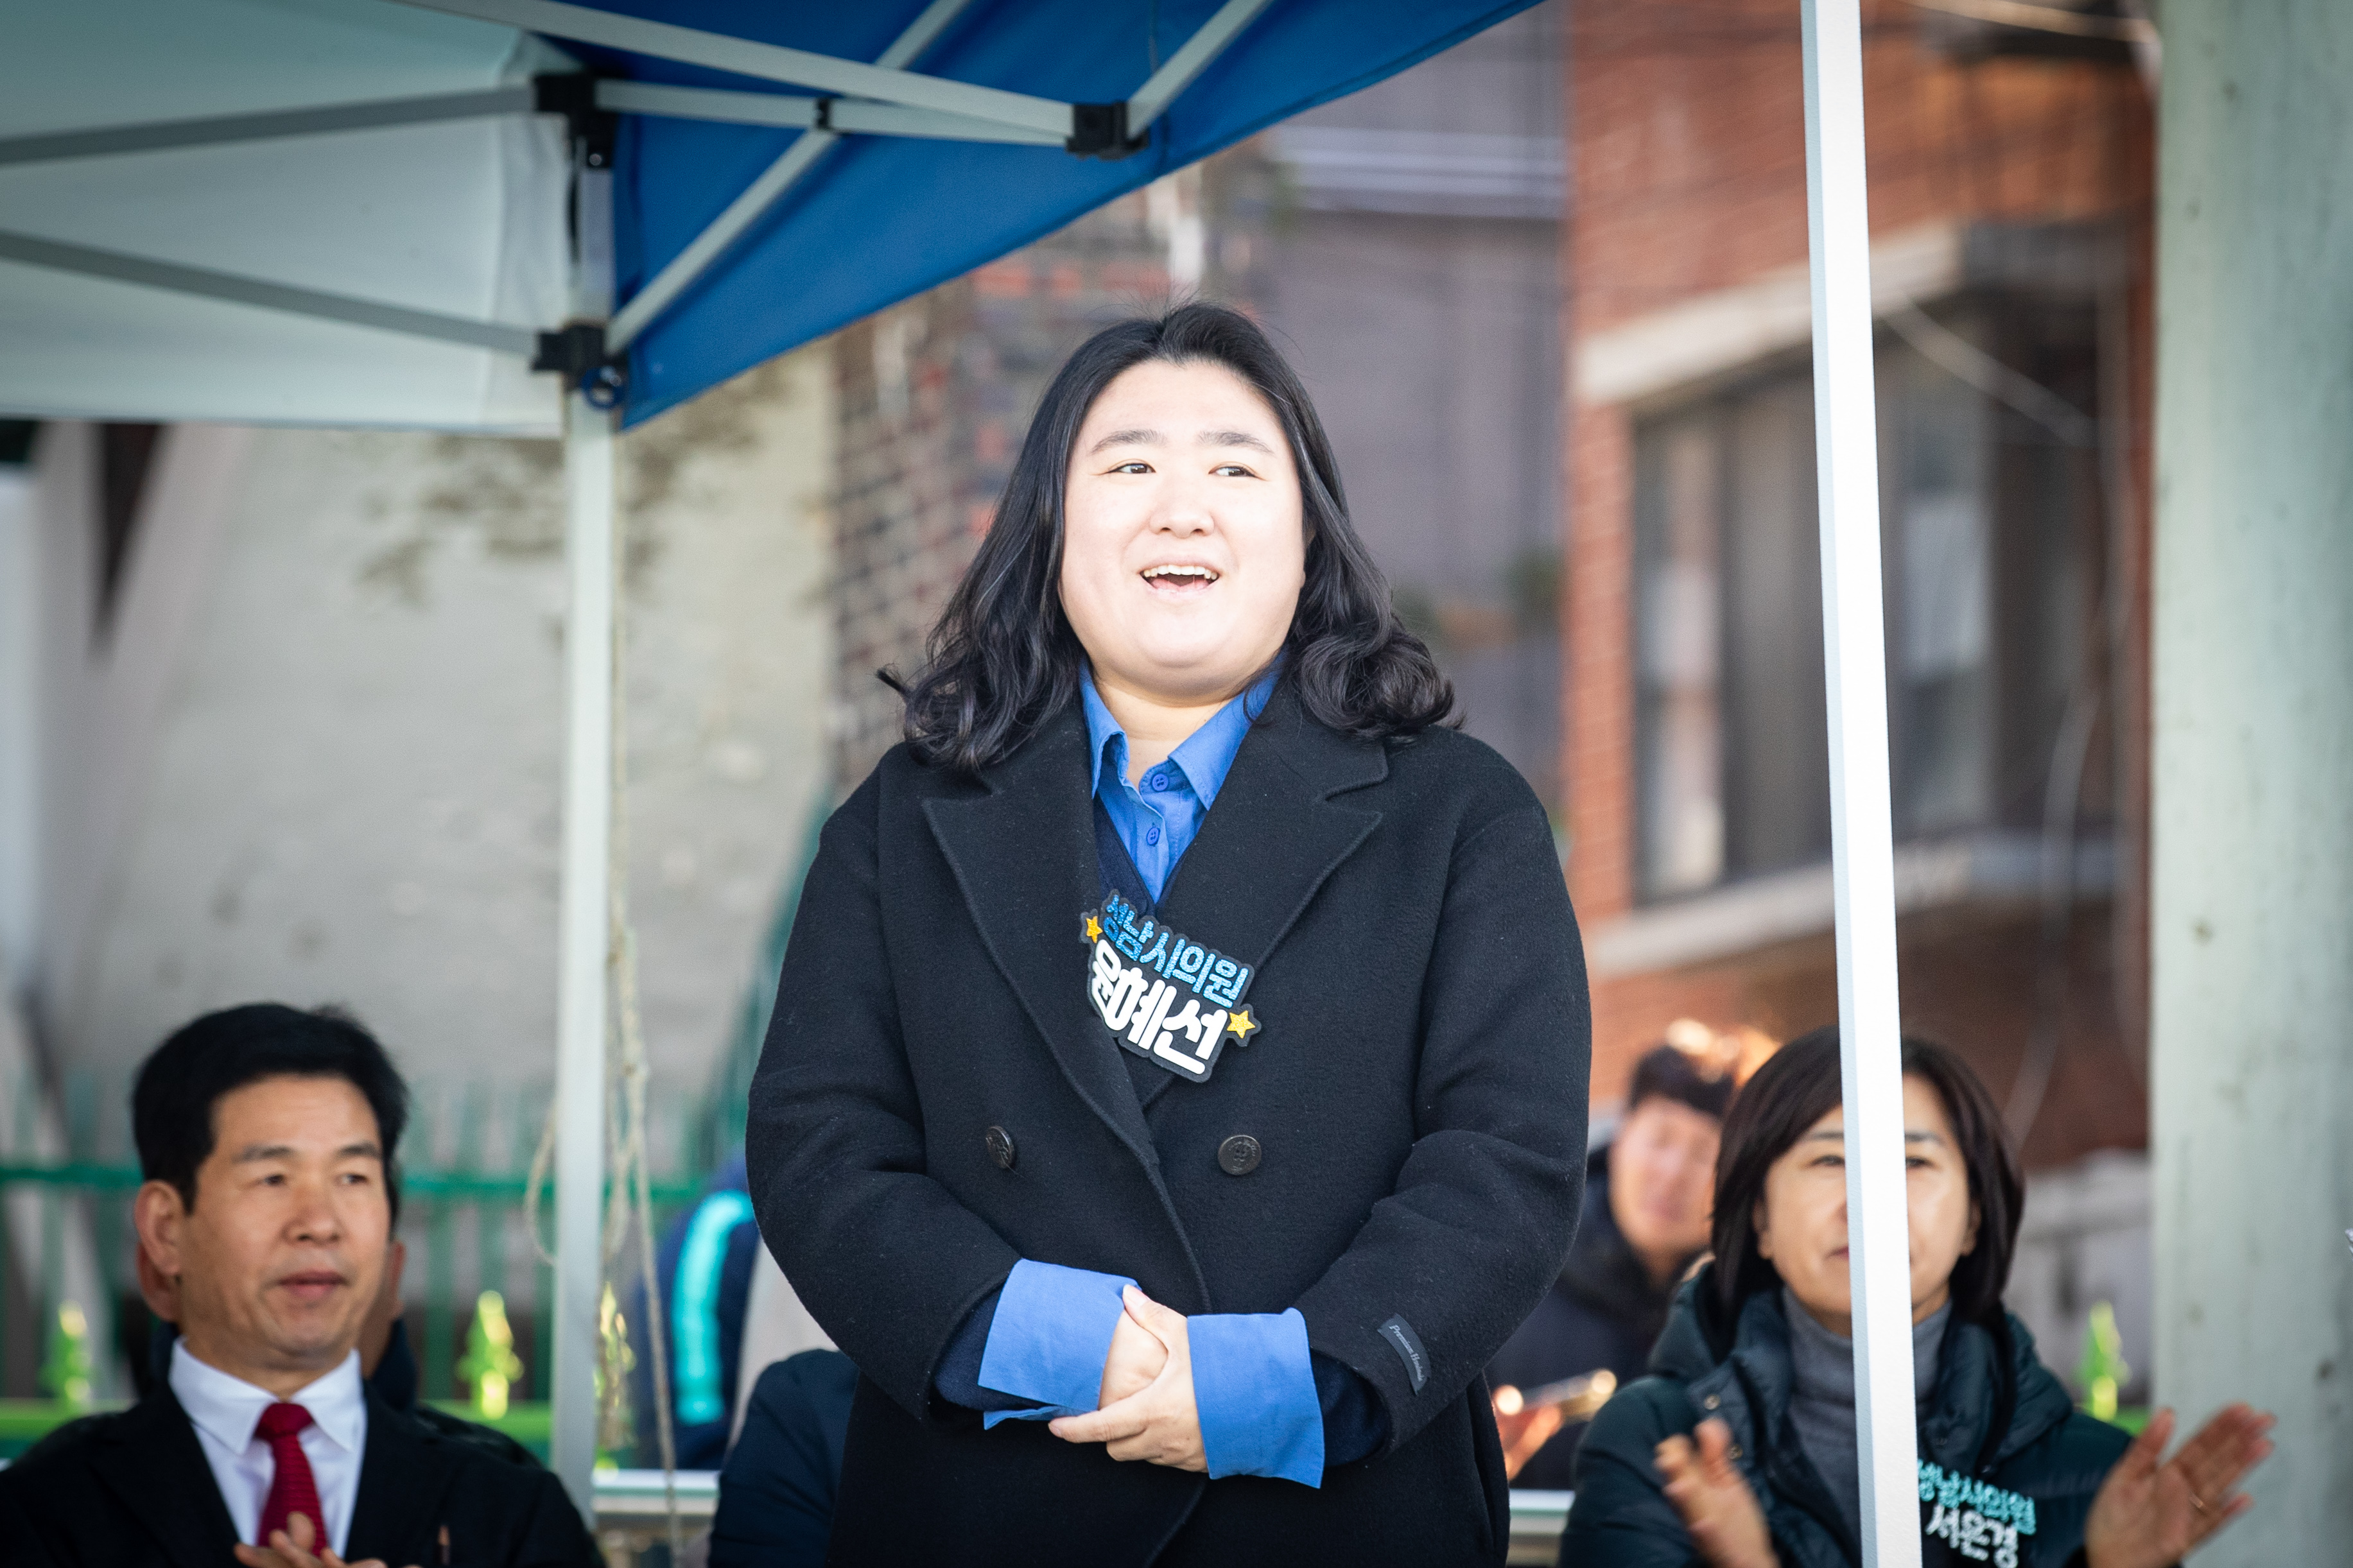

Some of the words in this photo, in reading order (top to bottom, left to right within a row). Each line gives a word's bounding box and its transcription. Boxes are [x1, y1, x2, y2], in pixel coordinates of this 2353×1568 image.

[1092, 939, 1228, 1074] 윤혜선
[1104, 895, 1249, 1008] 성남시의원
[1925, 1504, 2019, 1568] 서은경
